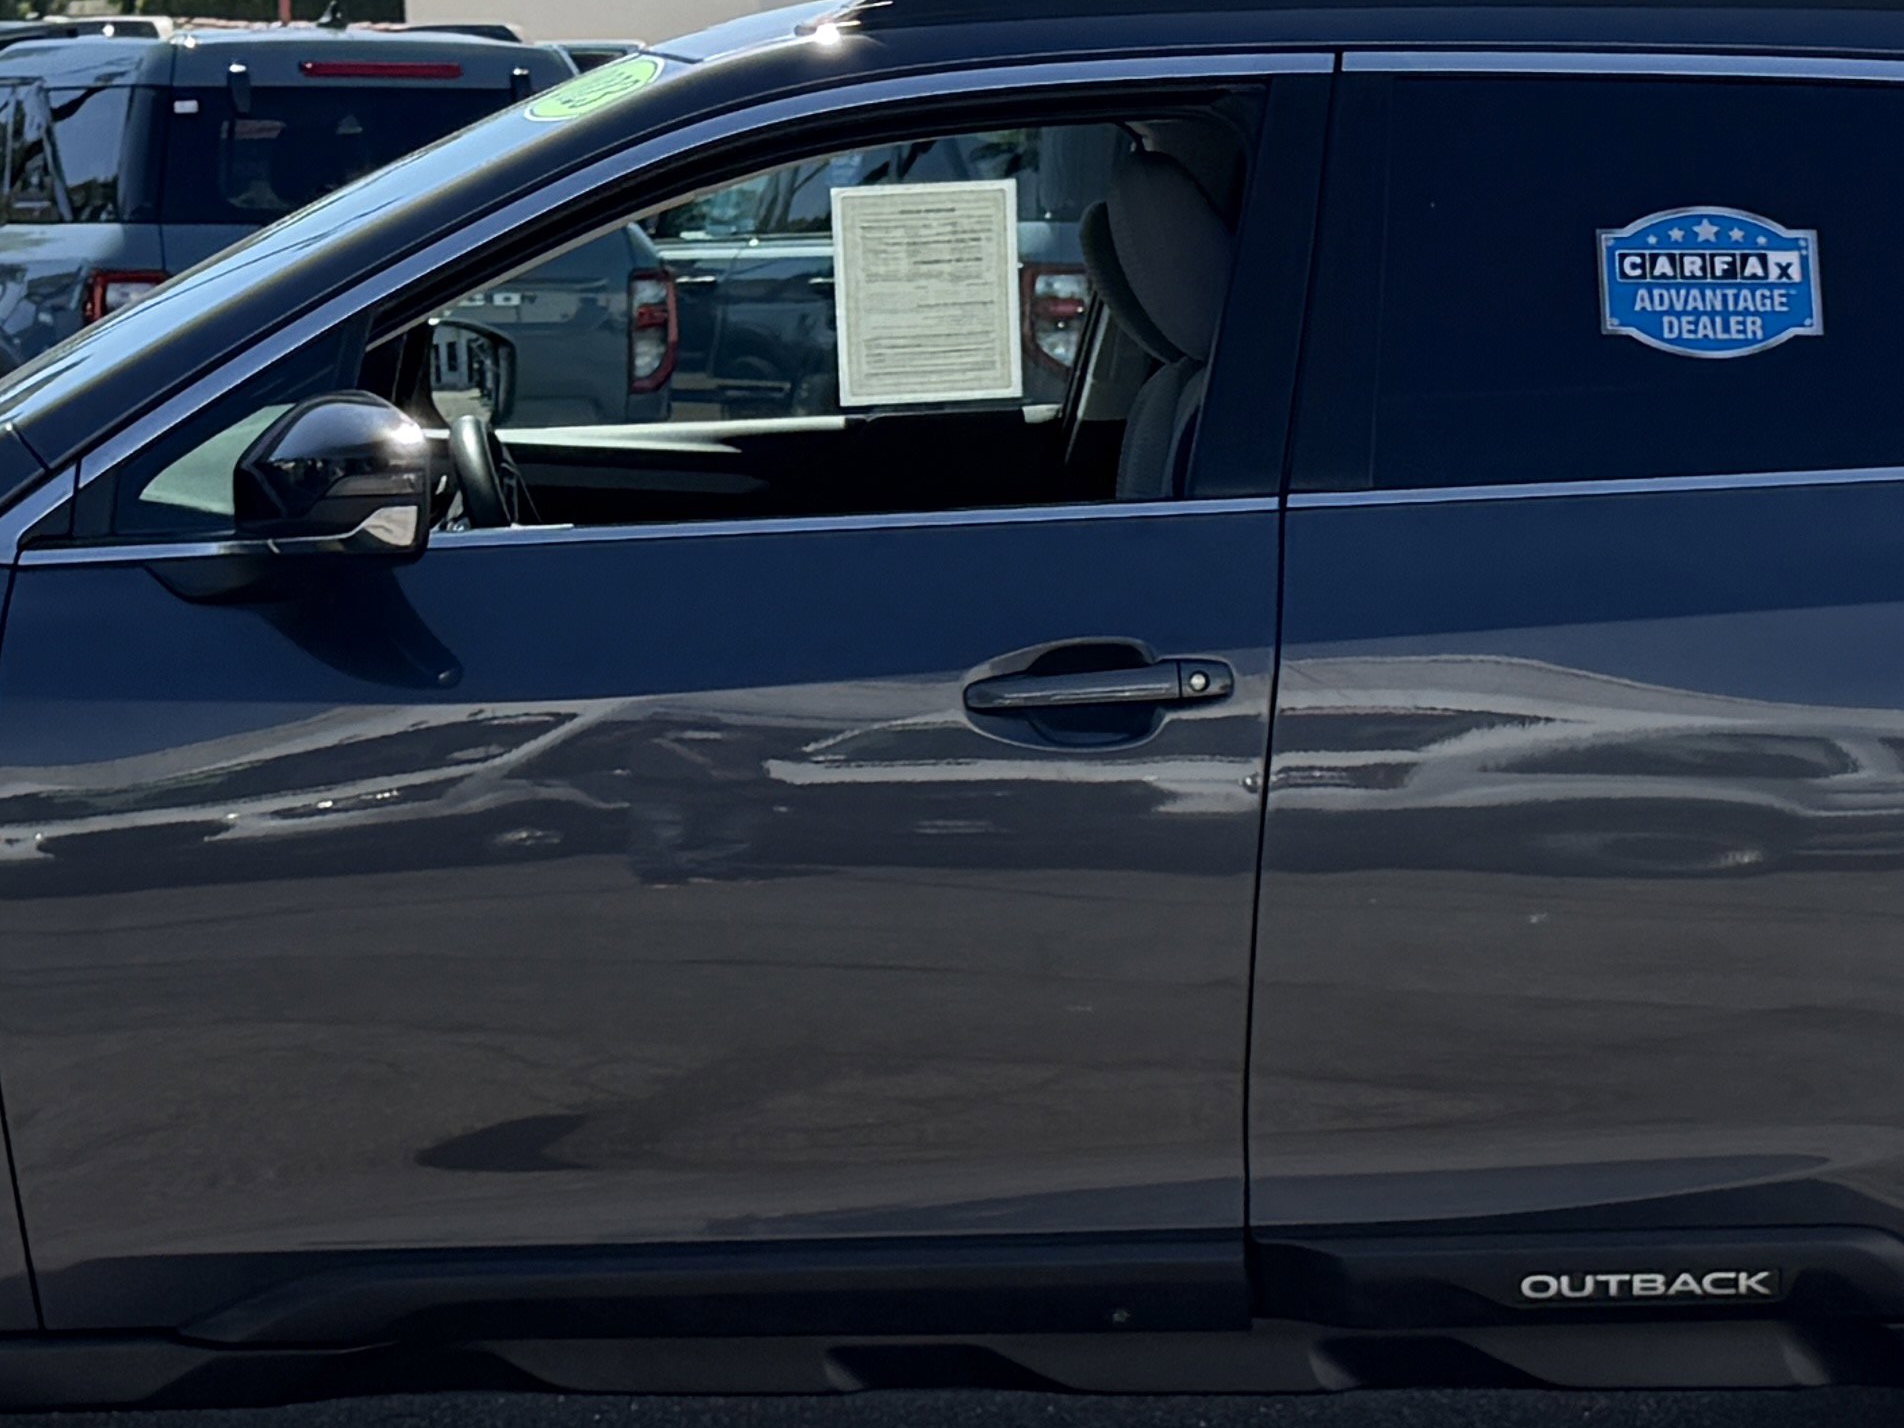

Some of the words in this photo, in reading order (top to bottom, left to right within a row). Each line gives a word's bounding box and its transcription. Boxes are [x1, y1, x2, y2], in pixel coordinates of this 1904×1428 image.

[1620, 254, 1796, 281] CARFAX
[1633, 288, 1790, 312] ADVANTAGE
[1662, 315, 1764, 340] DEALER
[1520, 1271, 1772, 1299] OUTBACK
